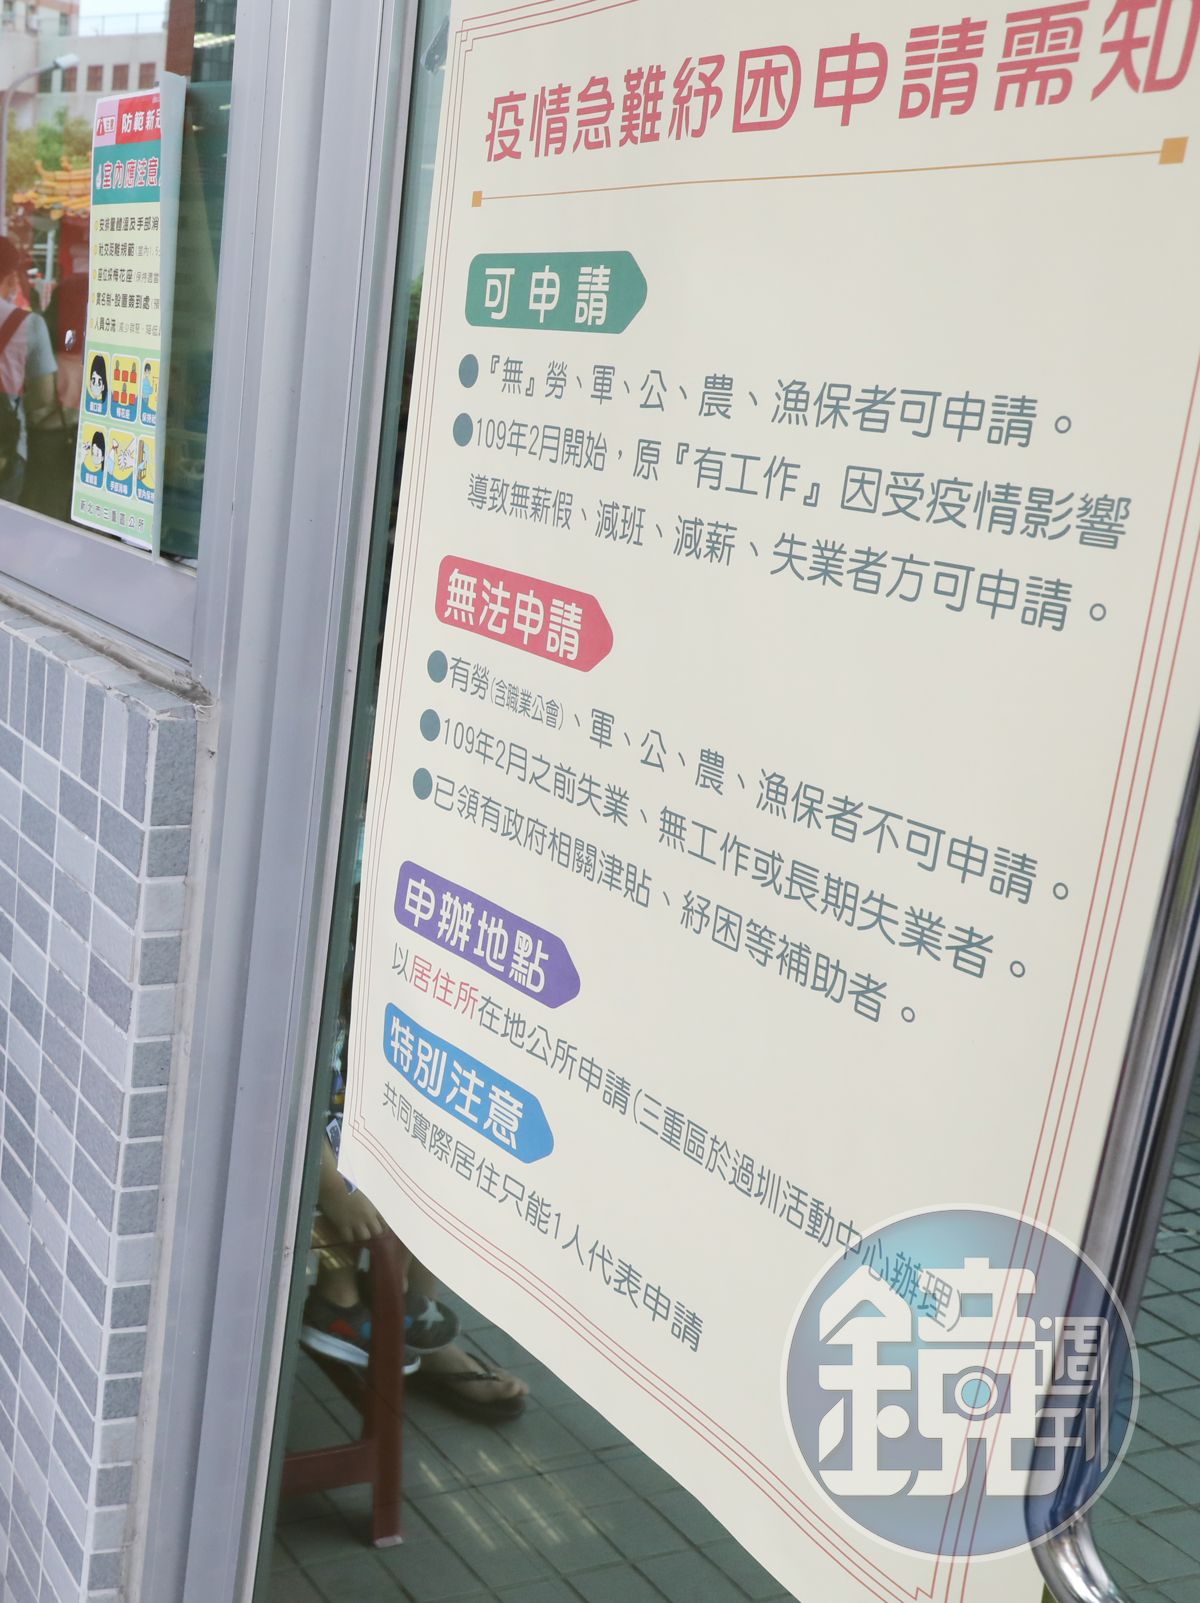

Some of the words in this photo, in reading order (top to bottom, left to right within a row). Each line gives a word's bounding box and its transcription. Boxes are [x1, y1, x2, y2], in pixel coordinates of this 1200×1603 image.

[485, 0, 1200, 163] 疫情急難紓困申請需知
[101, 156, 162, 190] 室內應注意
[484, 264, 612, 326] 可申請
[445, 567, 585, 661] 無法申請
[403, 878, 550, 994] 申辦地點
[434, 773, 918, 1025] 已領有政府相關津貼、紓困等補助者。
[390, 1015, 524, 1150] 特別注意
